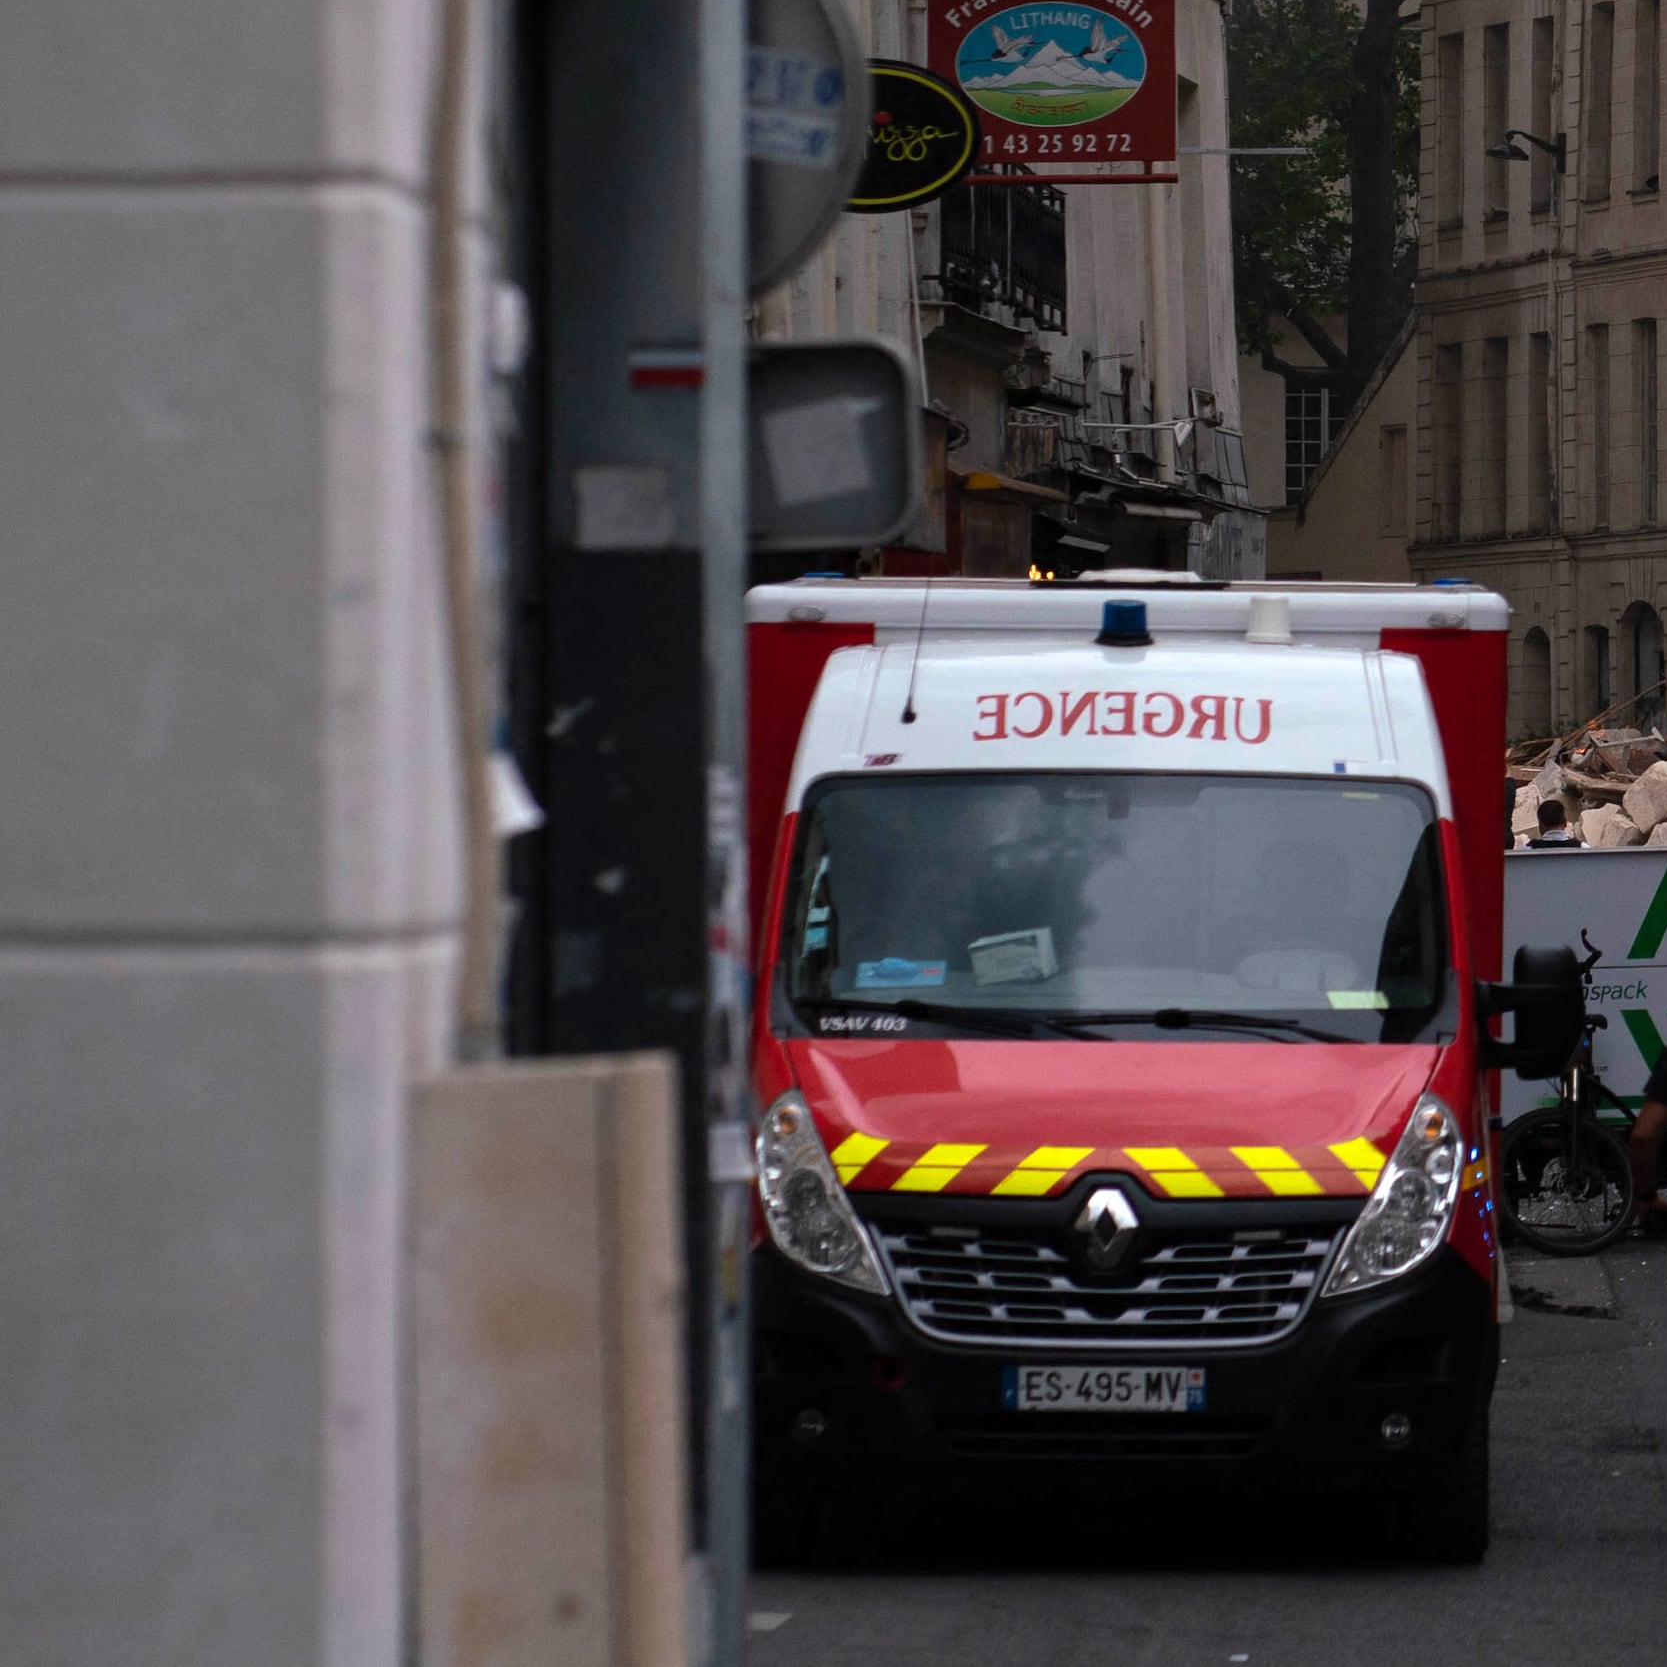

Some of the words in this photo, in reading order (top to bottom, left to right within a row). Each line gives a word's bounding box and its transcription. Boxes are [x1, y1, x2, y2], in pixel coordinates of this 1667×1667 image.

[1009, 10, 1093, 31] LITHANG
[864, 110, 961, 161] izza
[1003, 134, 1029, 153] 43
[1037, 134, 1063, 154] 25
[1072, 134, 1097, 153] 92
[1106, 134, 1132, 153] 72
[819, 1016, 869, 1032] VSAV
[870, 1016, 909, 1032] 403
[1025, 1371, 1183, 1403] ES-495-MV
